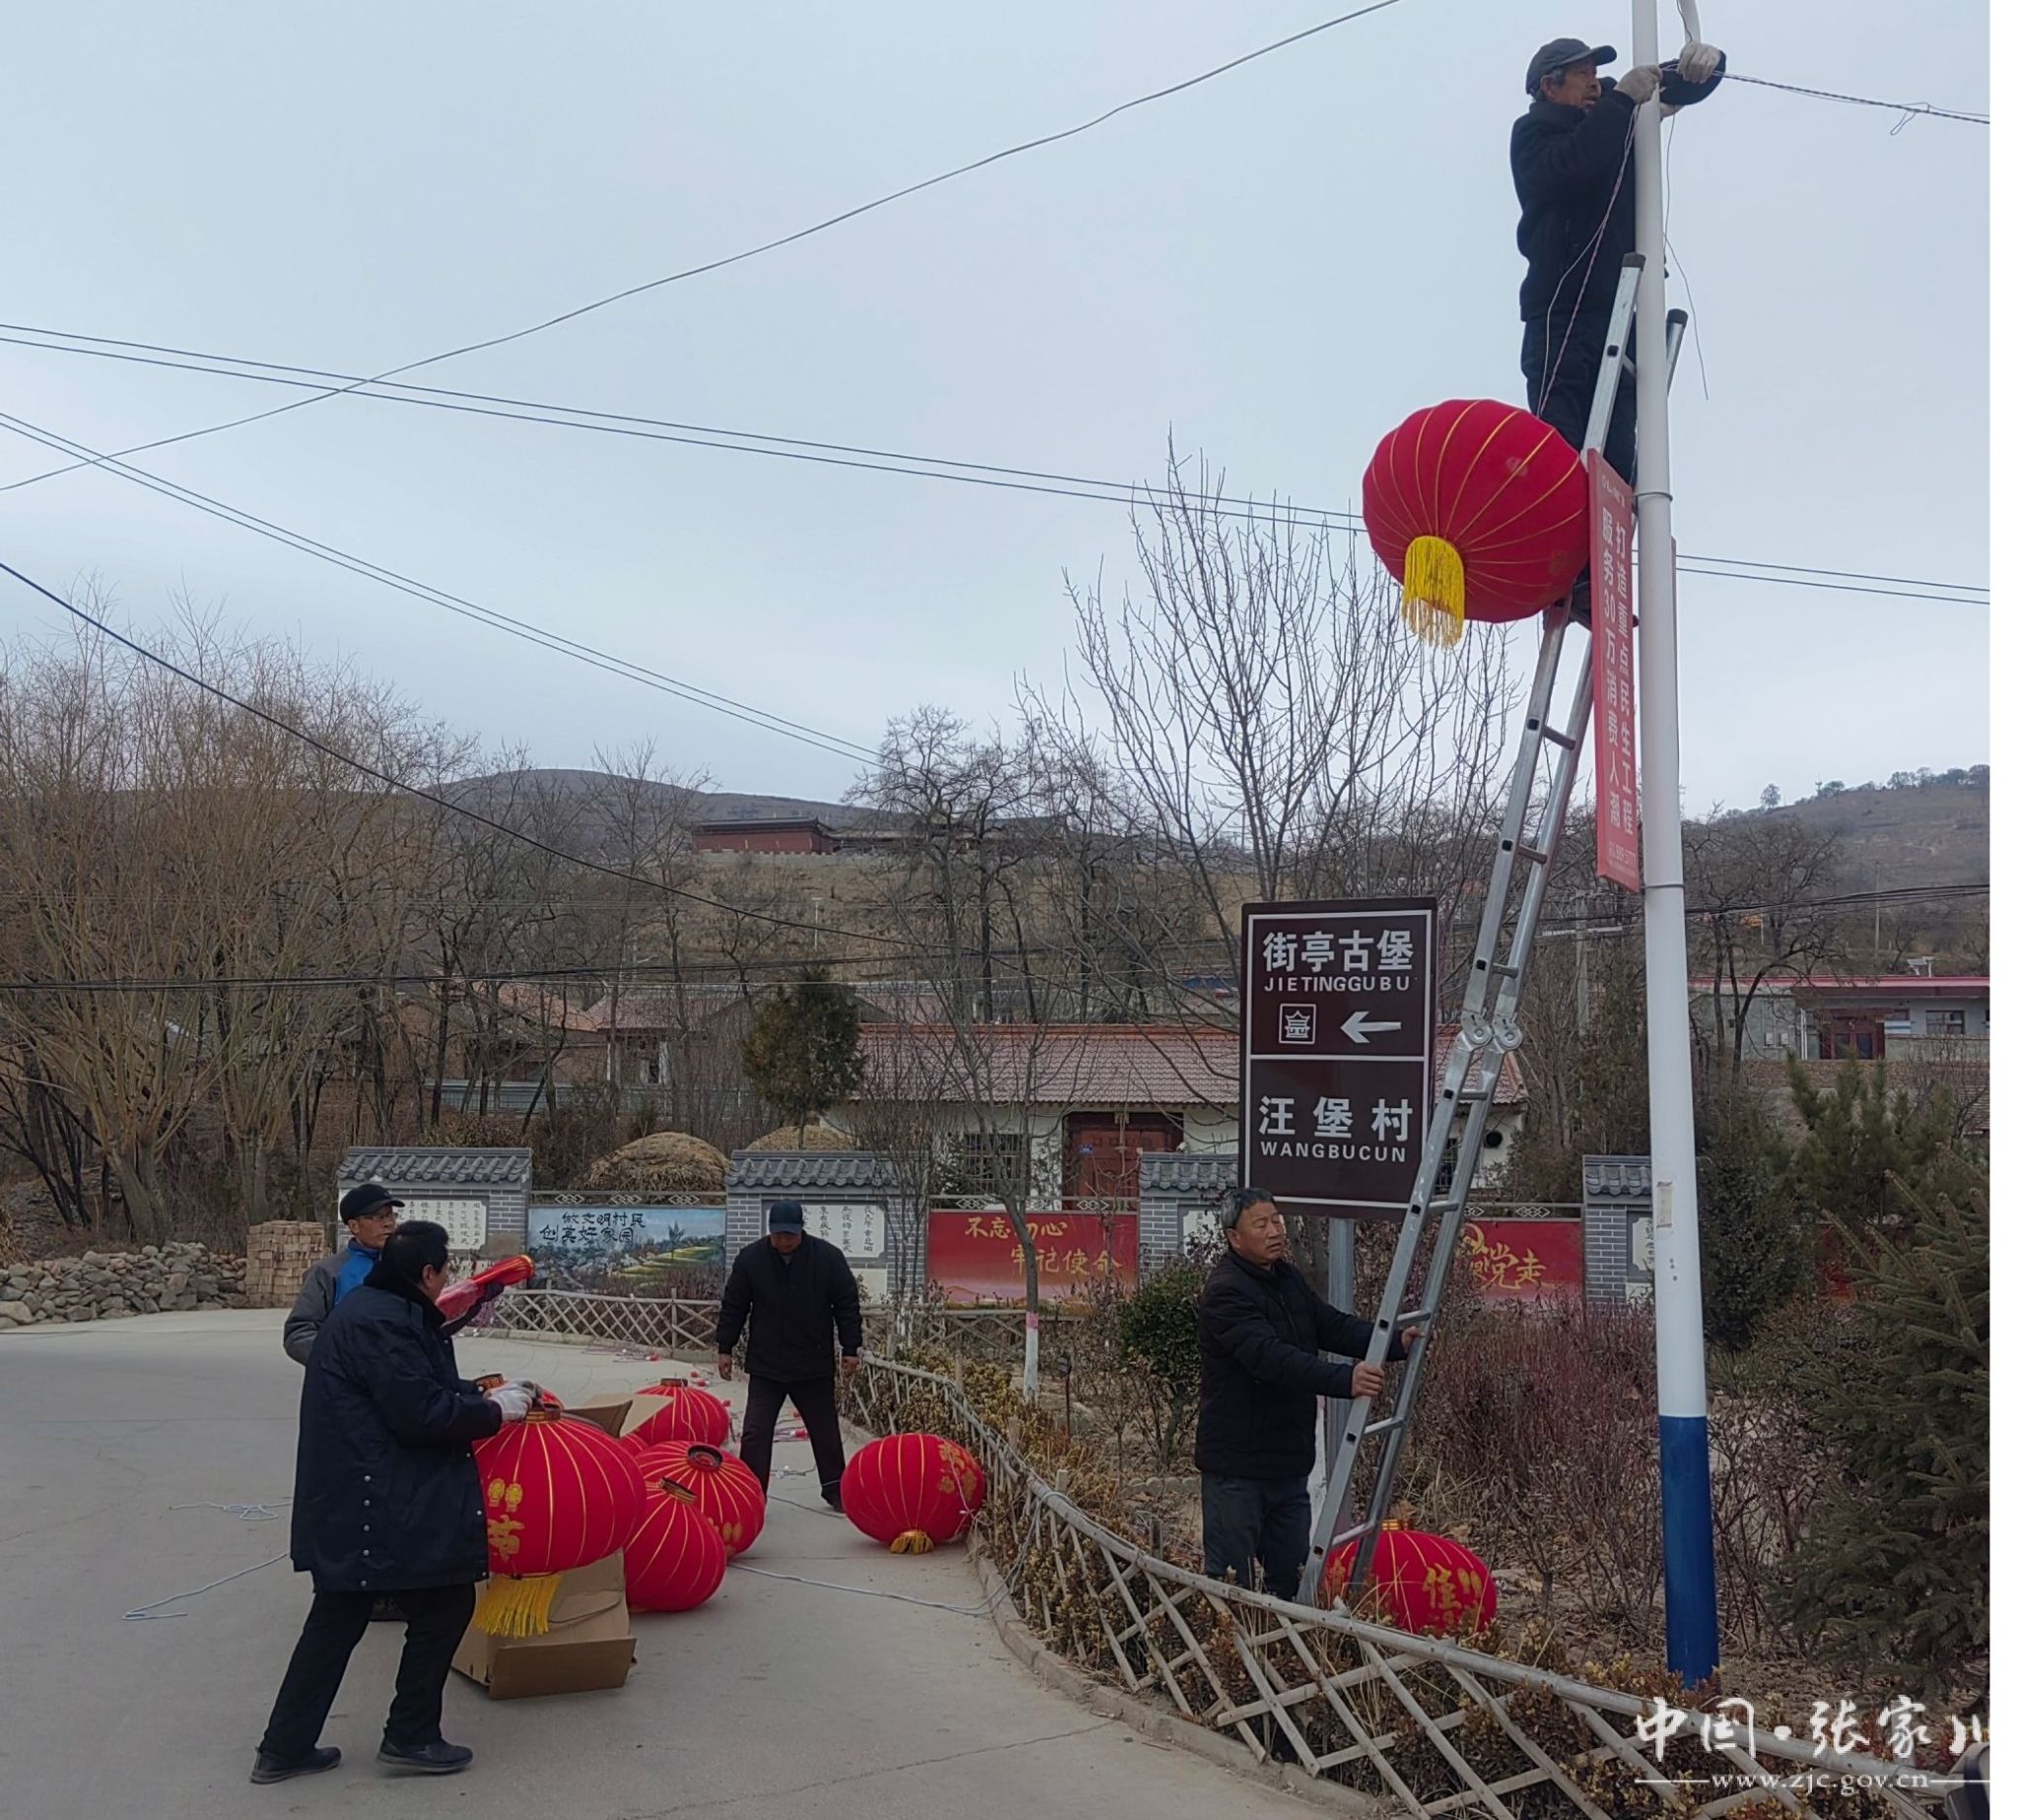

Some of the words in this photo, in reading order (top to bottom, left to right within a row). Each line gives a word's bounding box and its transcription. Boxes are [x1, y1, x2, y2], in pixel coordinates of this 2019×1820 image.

[1617, 521, 1634, 835] 打造重点民生工程
[1263, 930, 1415, 972] 街亭古堡
[1258, 1095, 1413, 1142] 汪堡村
[1260, 1141, 1406, 1162] WANGBUCUN
[539, 1225, 634, 1242] 创美好家园
[561, 1212, 646, 1227] 做文明村民
